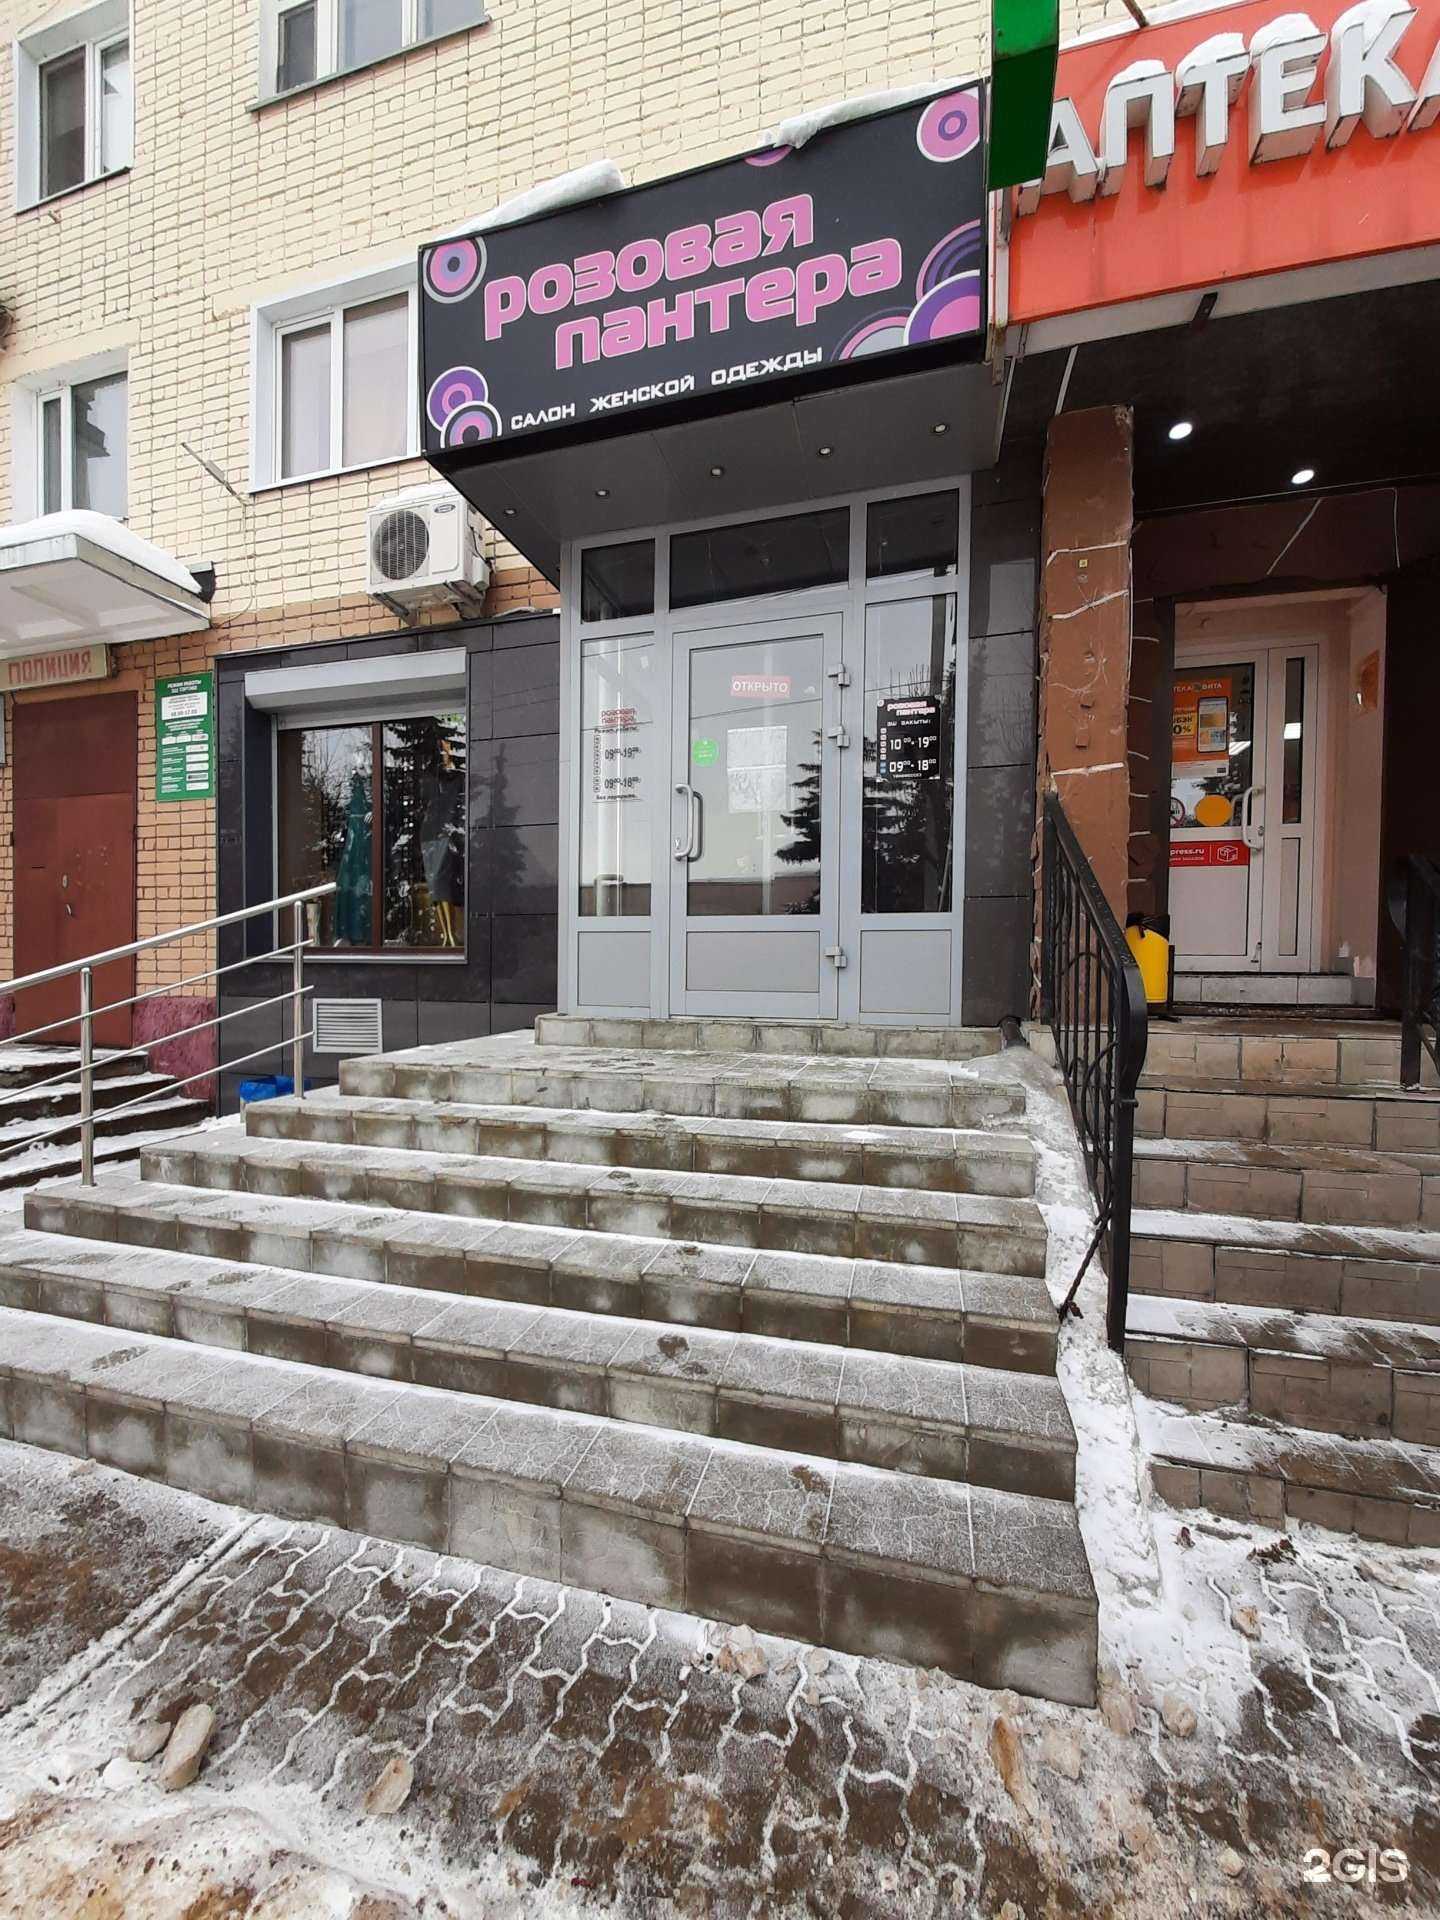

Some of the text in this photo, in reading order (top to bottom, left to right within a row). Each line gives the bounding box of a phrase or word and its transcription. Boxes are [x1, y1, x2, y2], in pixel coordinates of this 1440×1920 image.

[1019, 2, 1440, 205] АПТЕК
[511, 346, 823, 430] САЛОН ЖЕНСКОЙ ОДЕЖДЫ
[8, 650, 92, 684] ПОЛИЦИЯ
[733, 680, 788, 693] ОТКРЫТО
